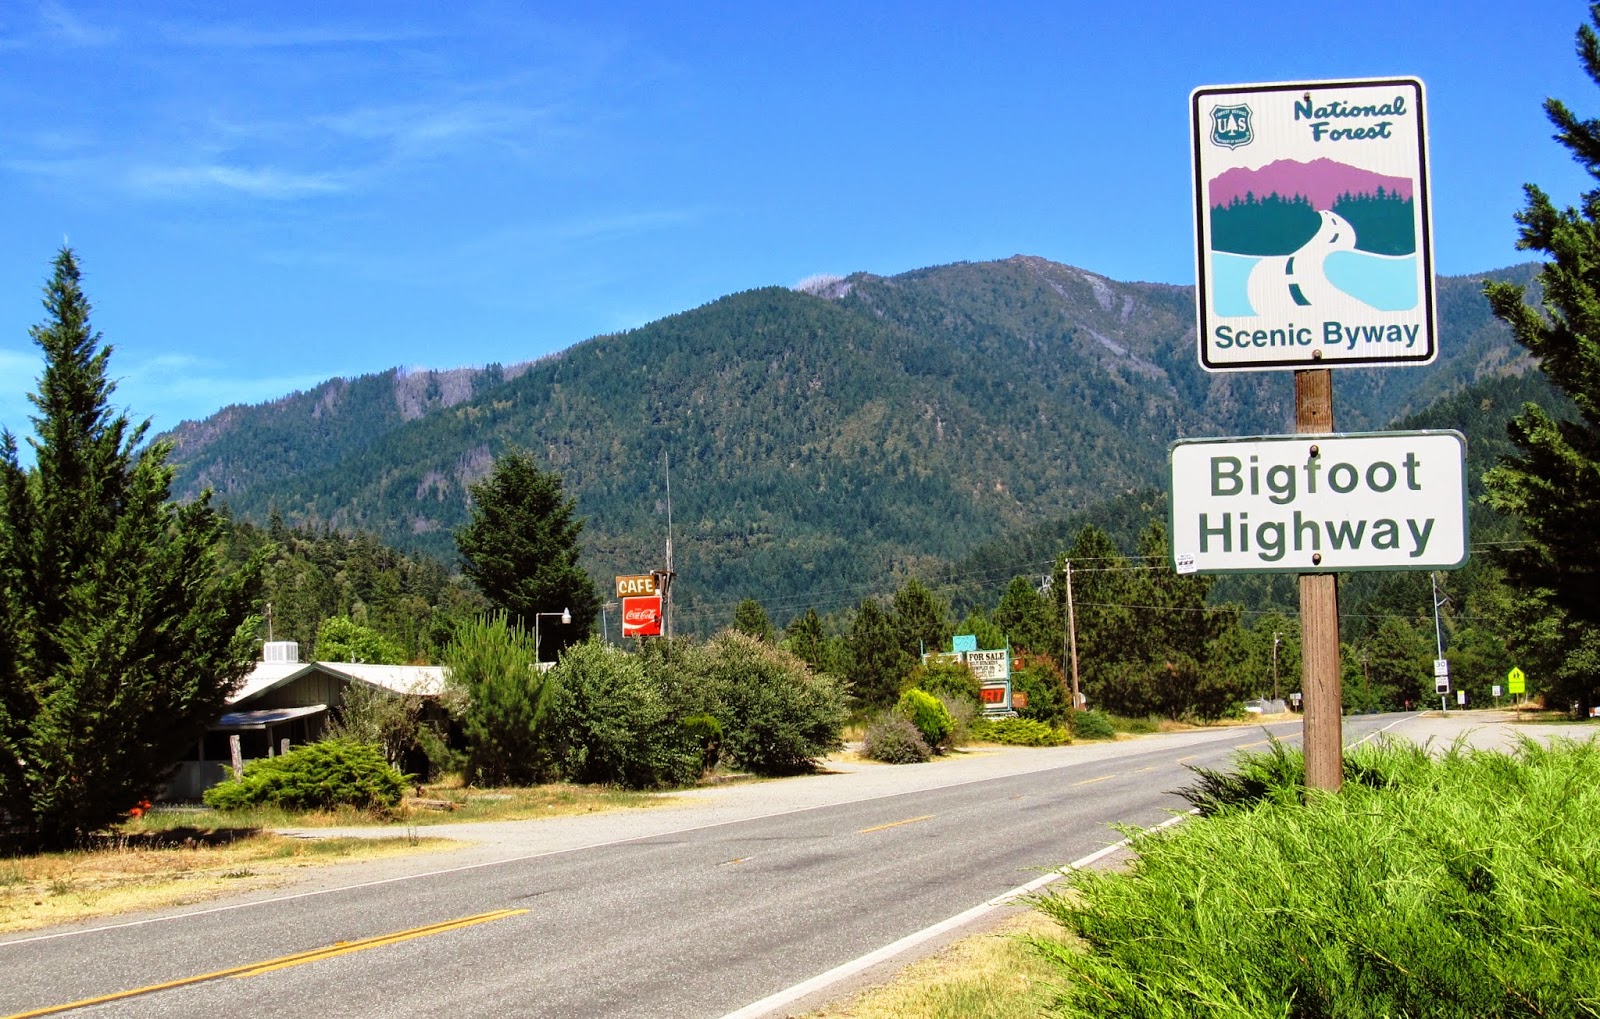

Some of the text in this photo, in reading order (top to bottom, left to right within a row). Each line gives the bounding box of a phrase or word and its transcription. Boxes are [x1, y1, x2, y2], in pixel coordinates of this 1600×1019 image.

[1294, 95, 1407, 121] National
[1309, 121, 1393, 142] Forest
[1215, 321, 1419, 350] Scenic Byway
[1210, 452, 1421, 505] Bigfoot
[1199, 510, 1435, 562] Highway
[619, 579, 653, 593] CAFE
[969, 653, 984, 661] FOR
